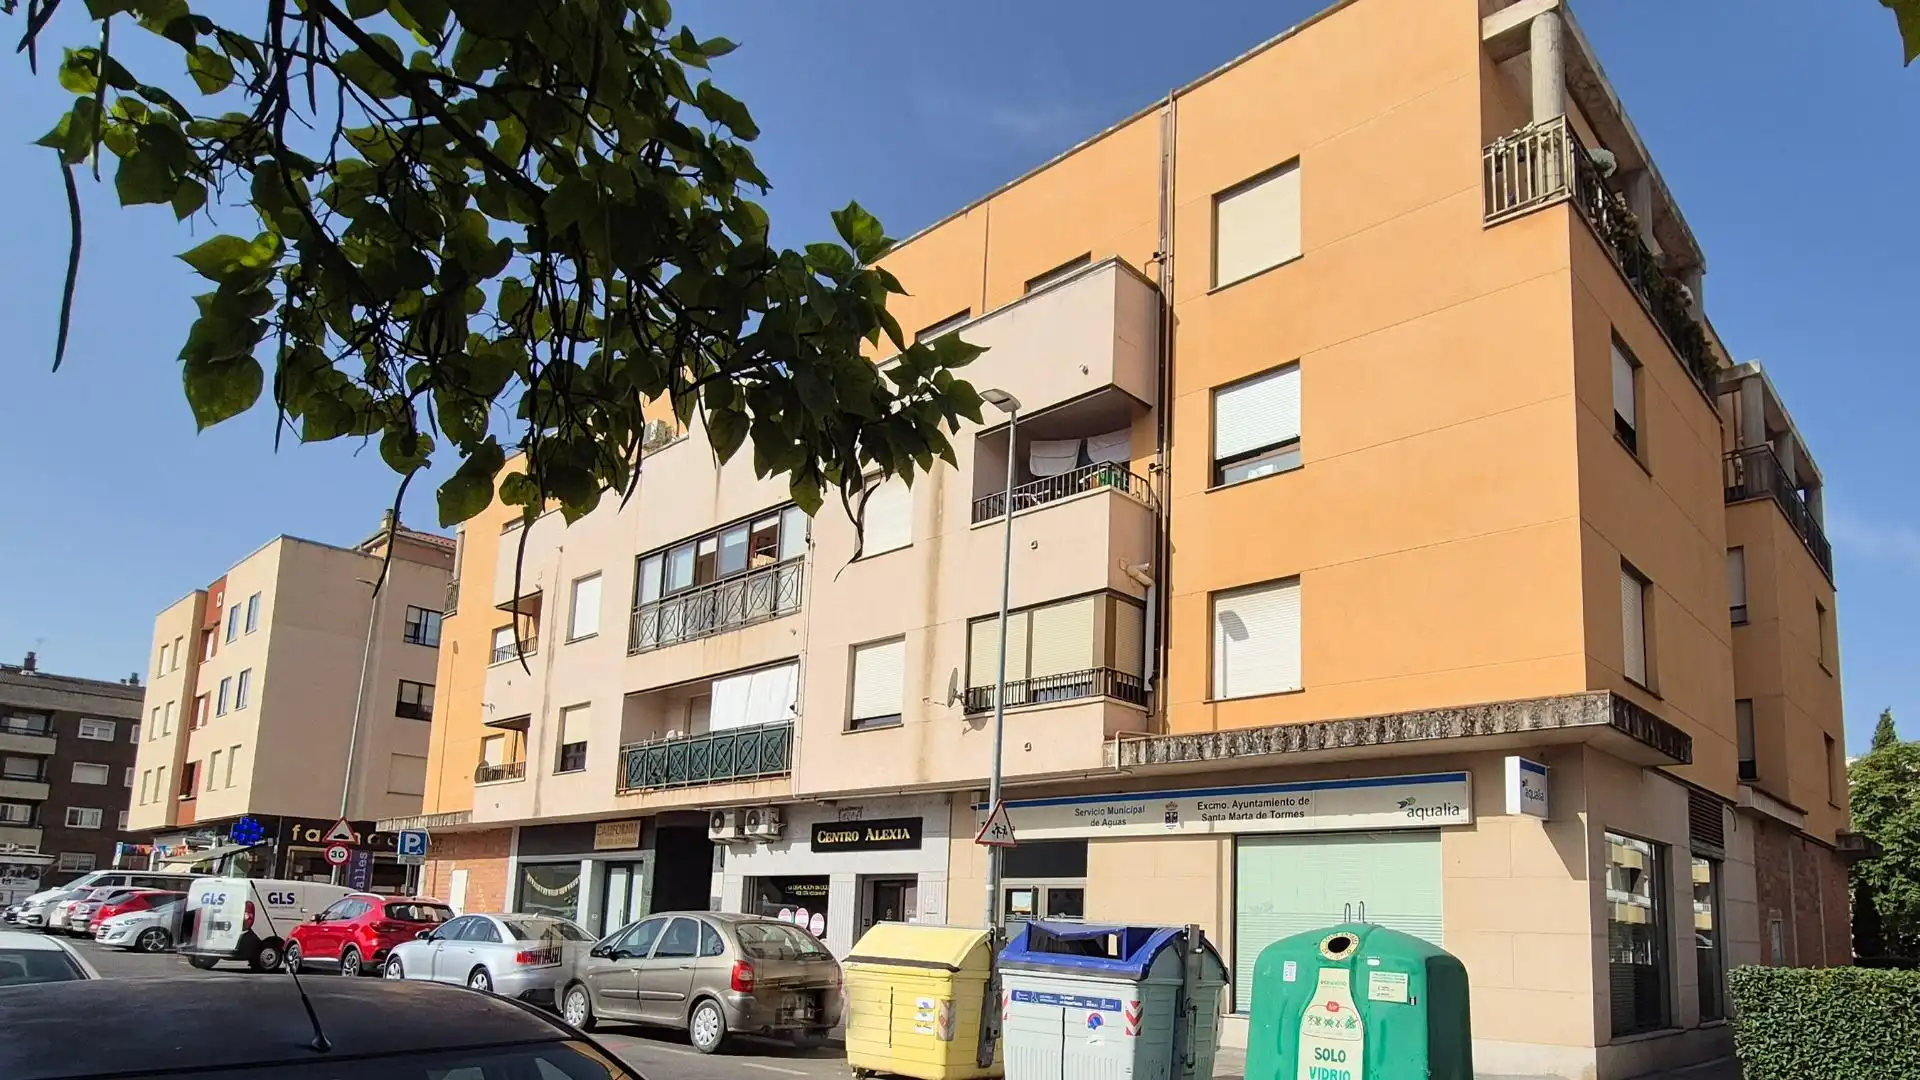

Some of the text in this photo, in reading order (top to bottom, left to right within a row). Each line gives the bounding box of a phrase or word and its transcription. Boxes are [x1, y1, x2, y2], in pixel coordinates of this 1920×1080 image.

[1197, 797, 1310, 810] Excmo. Ayuntamiento de
[1074, 805, 1145, 817] Servicio Municipal
[1201, 809, 1305, 822] Santa Marta de Tormes
[1406, 802, 1460, 820] aqualia
[1090, 818, 1127, 828] de Aguas
[331, 850, 345, 859] 30
[201, 892, 226, 906] GLS
[267, 892, 296, 905] GLS
[1314, 1047, 1347, 1063] SOLO
[1309, 1066, 1351, 1080] VIDRIO
